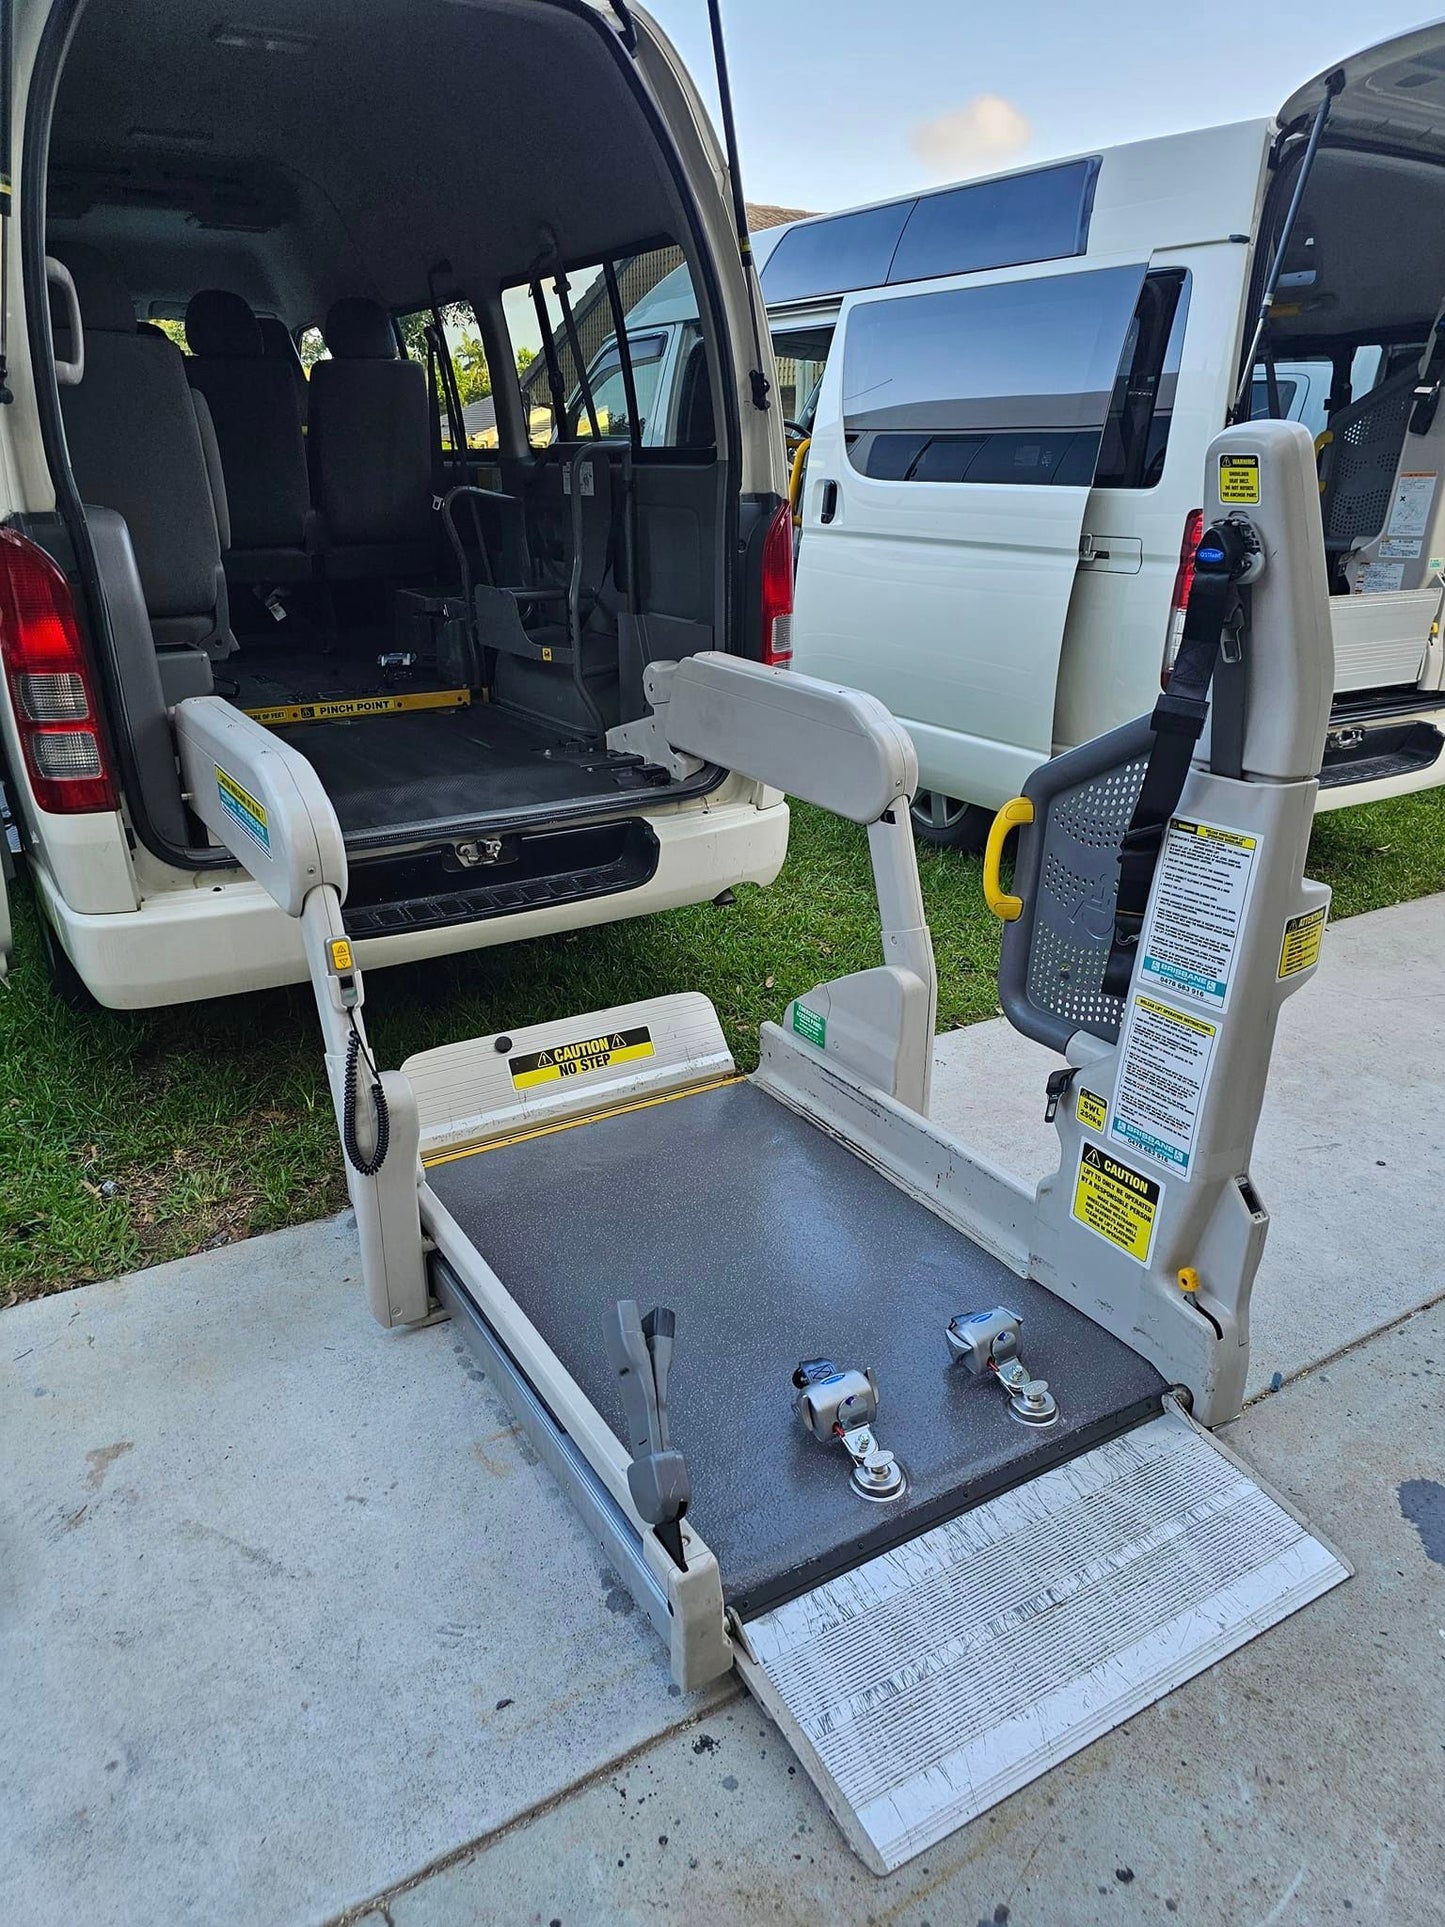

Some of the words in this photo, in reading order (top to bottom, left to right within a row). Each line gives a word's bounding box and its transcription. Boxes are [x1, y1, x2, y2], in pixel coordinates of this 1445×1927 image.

[320, 704, 354, 715] PINCH
[357, 701, 390, 711] POINT
[1160, 963, 1206, 984] BRISBANE
[553, 1037, 609, 1063] CAUTION
[558, 1061, 577, 1076] NO
[579, 1053, 611, 1071] STEP
[1079, 1108, 1101, 1126] 250kg
[1083, 1100, 1101, 1116] SWL
[1126, 1124, 1174, 1153] BRISBANE
[1103, 1159, 1148, 1194] CAUTION
[1081, 1175, 1088, 1183] BY
[1093, 1182, 1128, 1209] RESPONSIBLE
[1129, 1205, 1151, 1222] PERSON
[1083, 1167, 1093, 1177] LIFT
[1094, 1173, 1101, 1182] TO
[1102, 1178, 1115, 1190] ONLY
[1116, 1187, 1123, 1196] BE
[1124, 1192, 1152, 1213] OPERATED
